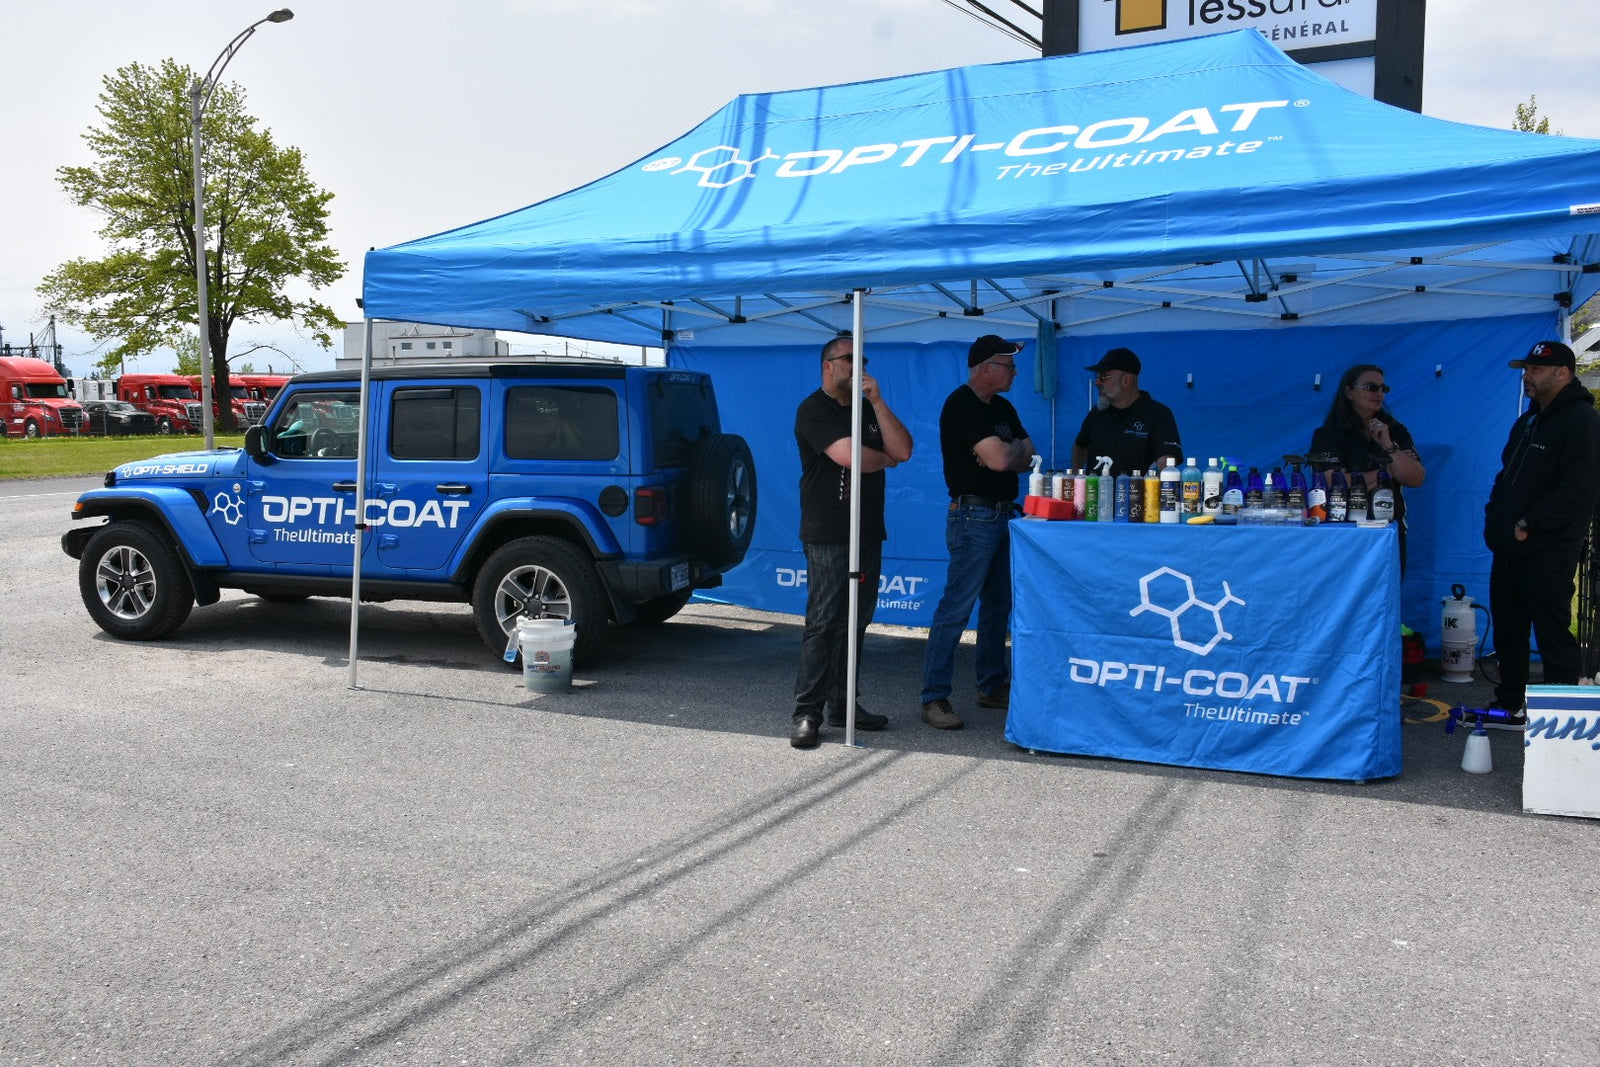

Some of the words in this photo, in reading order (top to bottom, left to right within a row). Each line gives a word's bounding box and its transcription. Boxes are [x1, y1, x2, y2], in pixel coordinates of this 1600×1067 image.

[133, 464, 208, 475] OPTI-SHIELD
[261, 495, 470, 529] OPTI-COAT
[877, 598, 920, 611] ltimate
[1068, 657, 1310, 703] OPTI-COAT
[1184, 703, 1302, 725] TheUltimate
